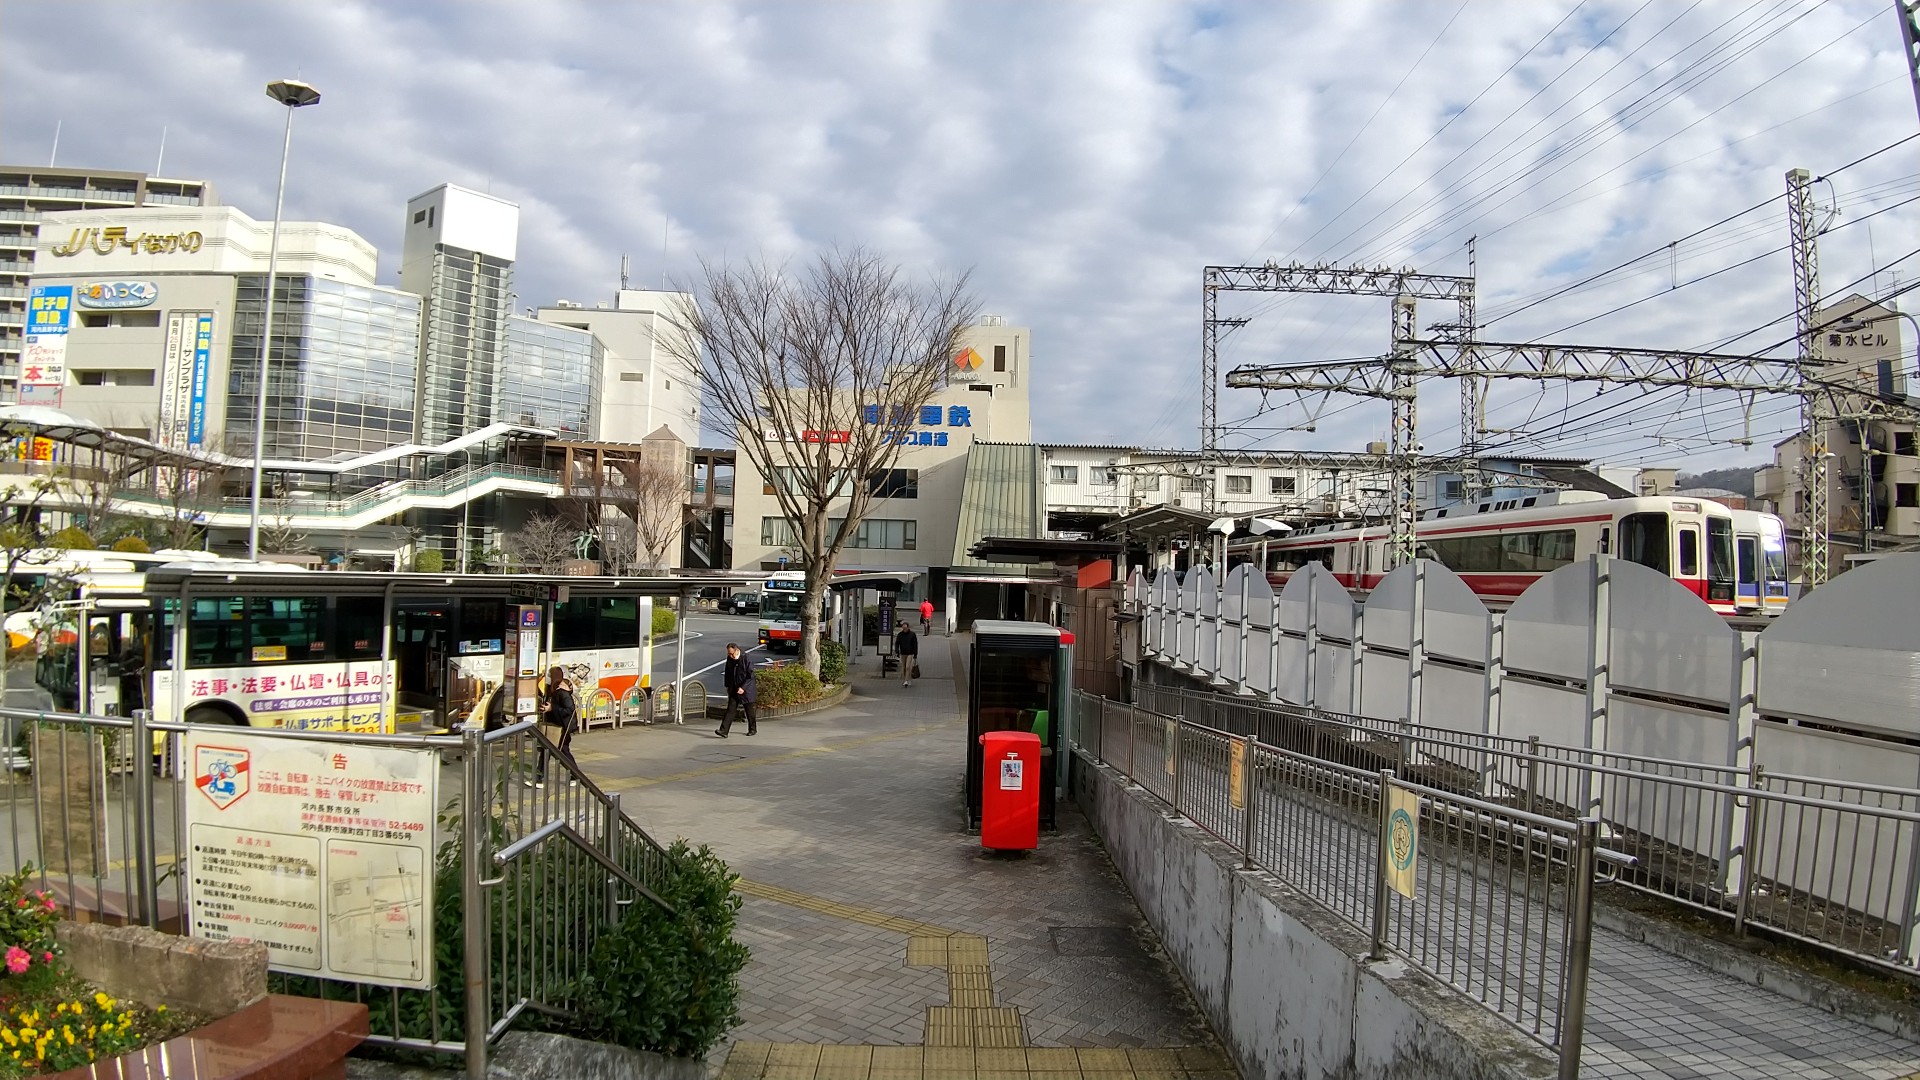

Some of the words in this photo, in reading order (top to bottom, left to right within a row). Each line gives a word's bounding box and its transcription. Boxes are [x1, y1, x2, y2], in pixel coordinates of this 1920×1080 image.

[1829, 333, 1889, 347] 菊水ビル
[24, 366, 43, 382] 本
[179, 349, 193, 394] サンプラザ
[527, 612, 535, 622] 3
[333, 753, 348, 770] 告
[301, 802, 360, 816] 河内長野市役所
[202, 878, 252, 892] 返還に必要なもの
